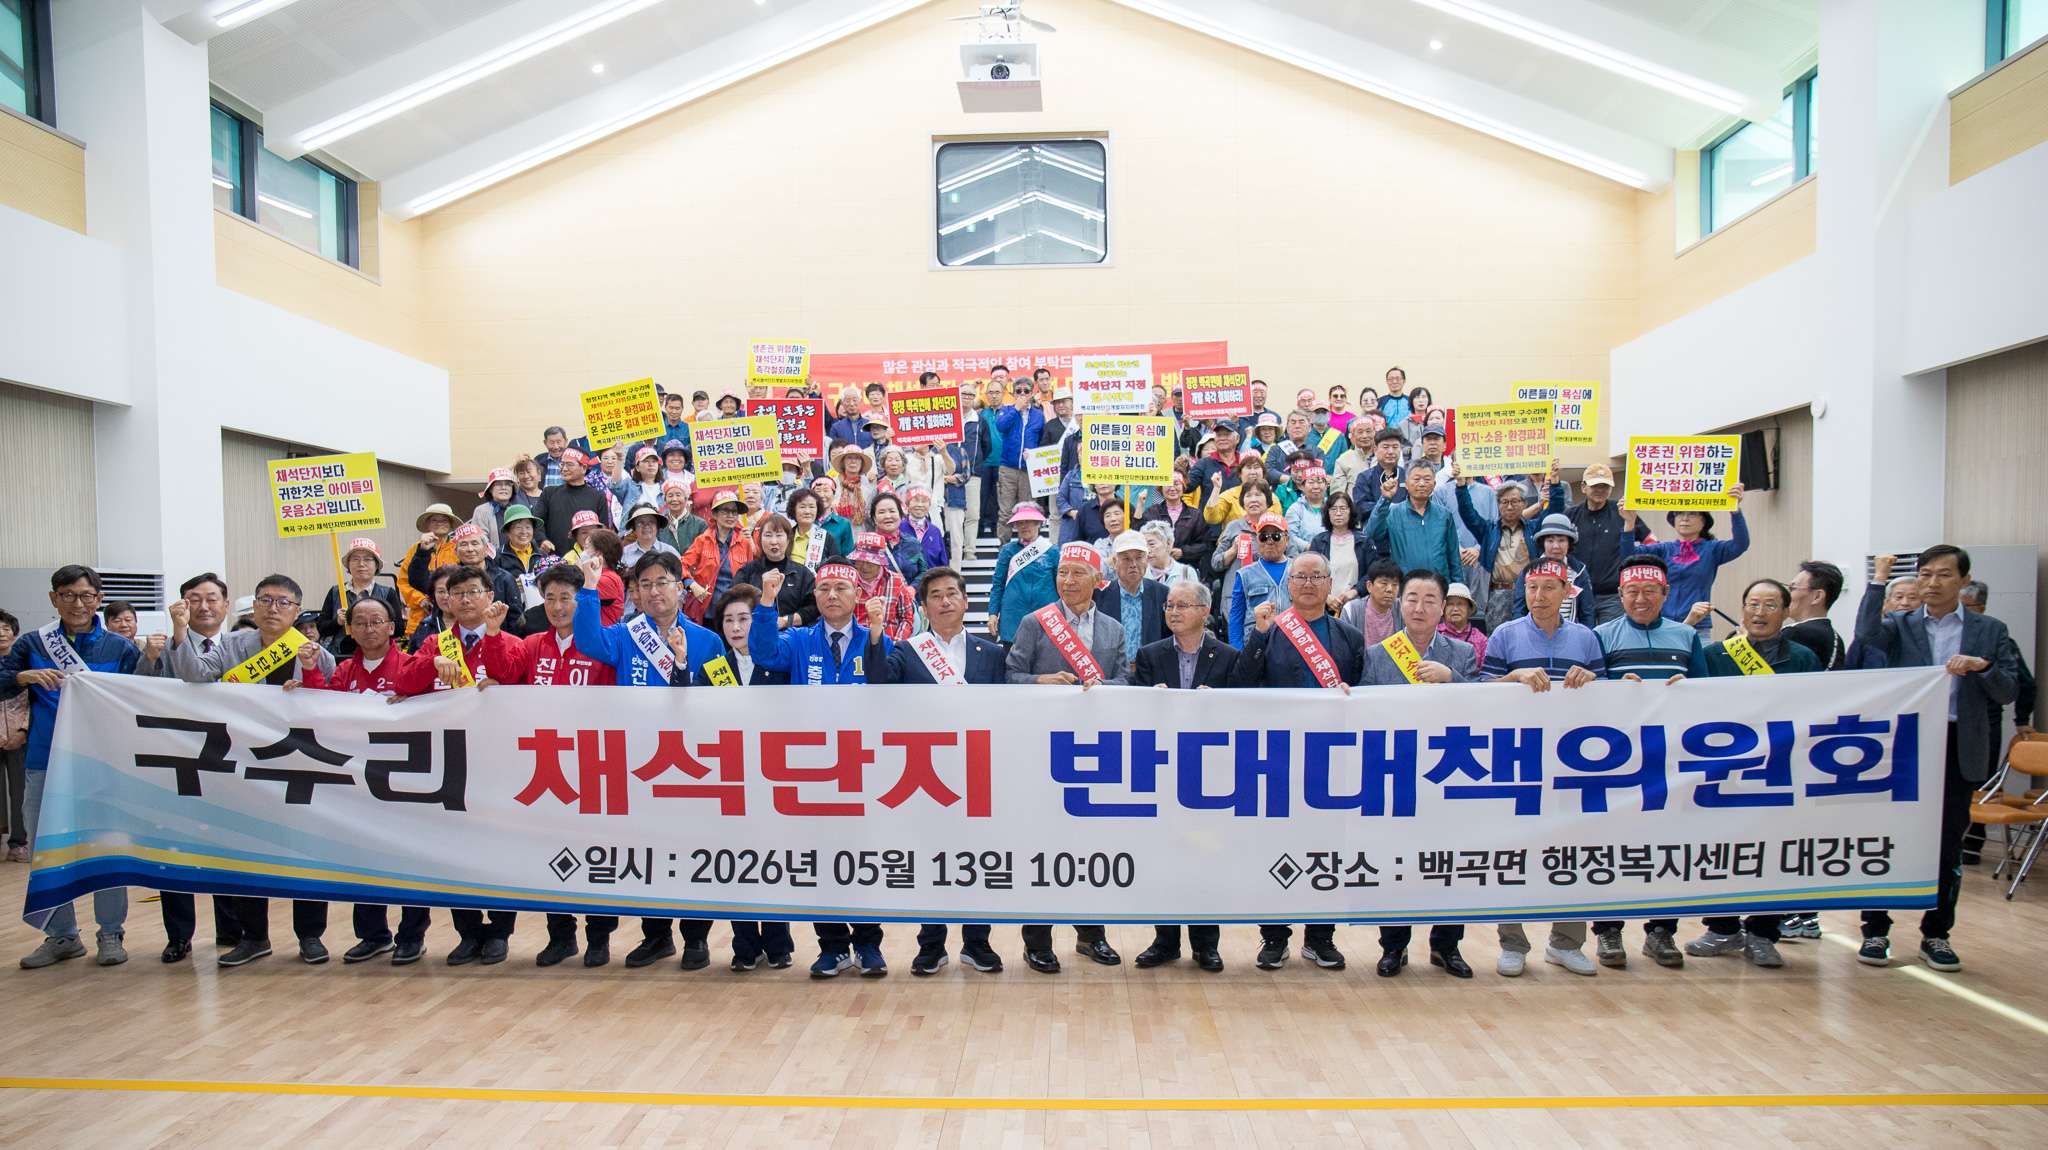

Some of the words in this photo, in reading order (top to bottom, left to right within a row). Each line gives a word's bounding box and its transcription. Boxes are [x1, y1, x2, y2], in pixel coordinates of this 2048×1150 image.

[755, 355, 785, 364] 채석단지
[787, 355, 802, 364] 개발
[882, 359, 909, 375] 많은
[911, 358, 949, 374] 관심과
[1005, 355, 1031, 371] 참여
[1518, 388, 1558, 400] 어른들의
[1562, 388, 1592, 400] 욕심에
[1561, 404, 1581, 415] 꿈이
[591, 426, 599, 436] 온
[600, 420, 623, 434] 군민은
[624, 416, 640, 429] 절대
[695, 425, 751, 441] 채석단지보다
[1090, 423, 1131, 436] 어른들의
[1135, 424, 1166, 437] 욕심에
[564, 448, 583, 460] 사반대
[697, 442, 735, 457] 귀한것은
[737, 438, 774, 453] 아이들의
[1090, 440, 1131, 452] 아이들의
[1135, 440, 1155, 452] 꿈이
[1462, 447, 1471, 460] 온
[1474, 445, 1502, 459] 군민은
[1505, 445, 1524, 457] 절대
[1527, 443, 1550, 456] 반대!
[1635, 445, 1674, 458] 생존권
[1679, 445, 1733, 458] 위협하는
[699, 455, 767, 472] 웃음소리입니다.
[1090, 455, 1120, 467] 병들어
[1124, 456, 1159, 468] 갑니다.
[1640, 462, 1693, 475] 채석단지
[1698, 462, 1726, 475] 개발
[276, 464, 345, 482] 채석단지보다
[279, 484, 324, 501] 귀한것은
[328, 479, 374, 495] 아이들의
[1641, 478, 1723, 492] 즉각철회하라
[281, 499, 365, 518] 웃음소리입니다.
[821, 566, 857, 583] 결사반대
[1622, 567, 1663, 582] 결사반대
[45, 629, 78, 670] 채석단지
[1729, 637, 1764, 675] 채석단지
[245, 642, 293, 680] 채석단지
[853, 656, 865, 676] 1
[919, 639, 956, 680] 채석단지
[135, 714, 467, 811] 구수리
[514, 729, 991, 817] 채석단지
[1050, 713, 1919, 818] 반대대책위원회
[584, 847, 653, 885] 일시
[669, 852, 678, 878] :
[690, 848, 818, 888] 2026년
[833, 849, 917, 889] 05월
[931, 850, 1013, 889] 13일
[1029, 851, 1135, 888] 10:00
[1305, 851, 1379, 891] 장소
[1395, 858, 1404, 882] :
[1418, 849, 1528, 888] 백곡면
[1542, 840, 1764, 886] 행정복지센터
[1780, 836, 1895, 876] 대강당
